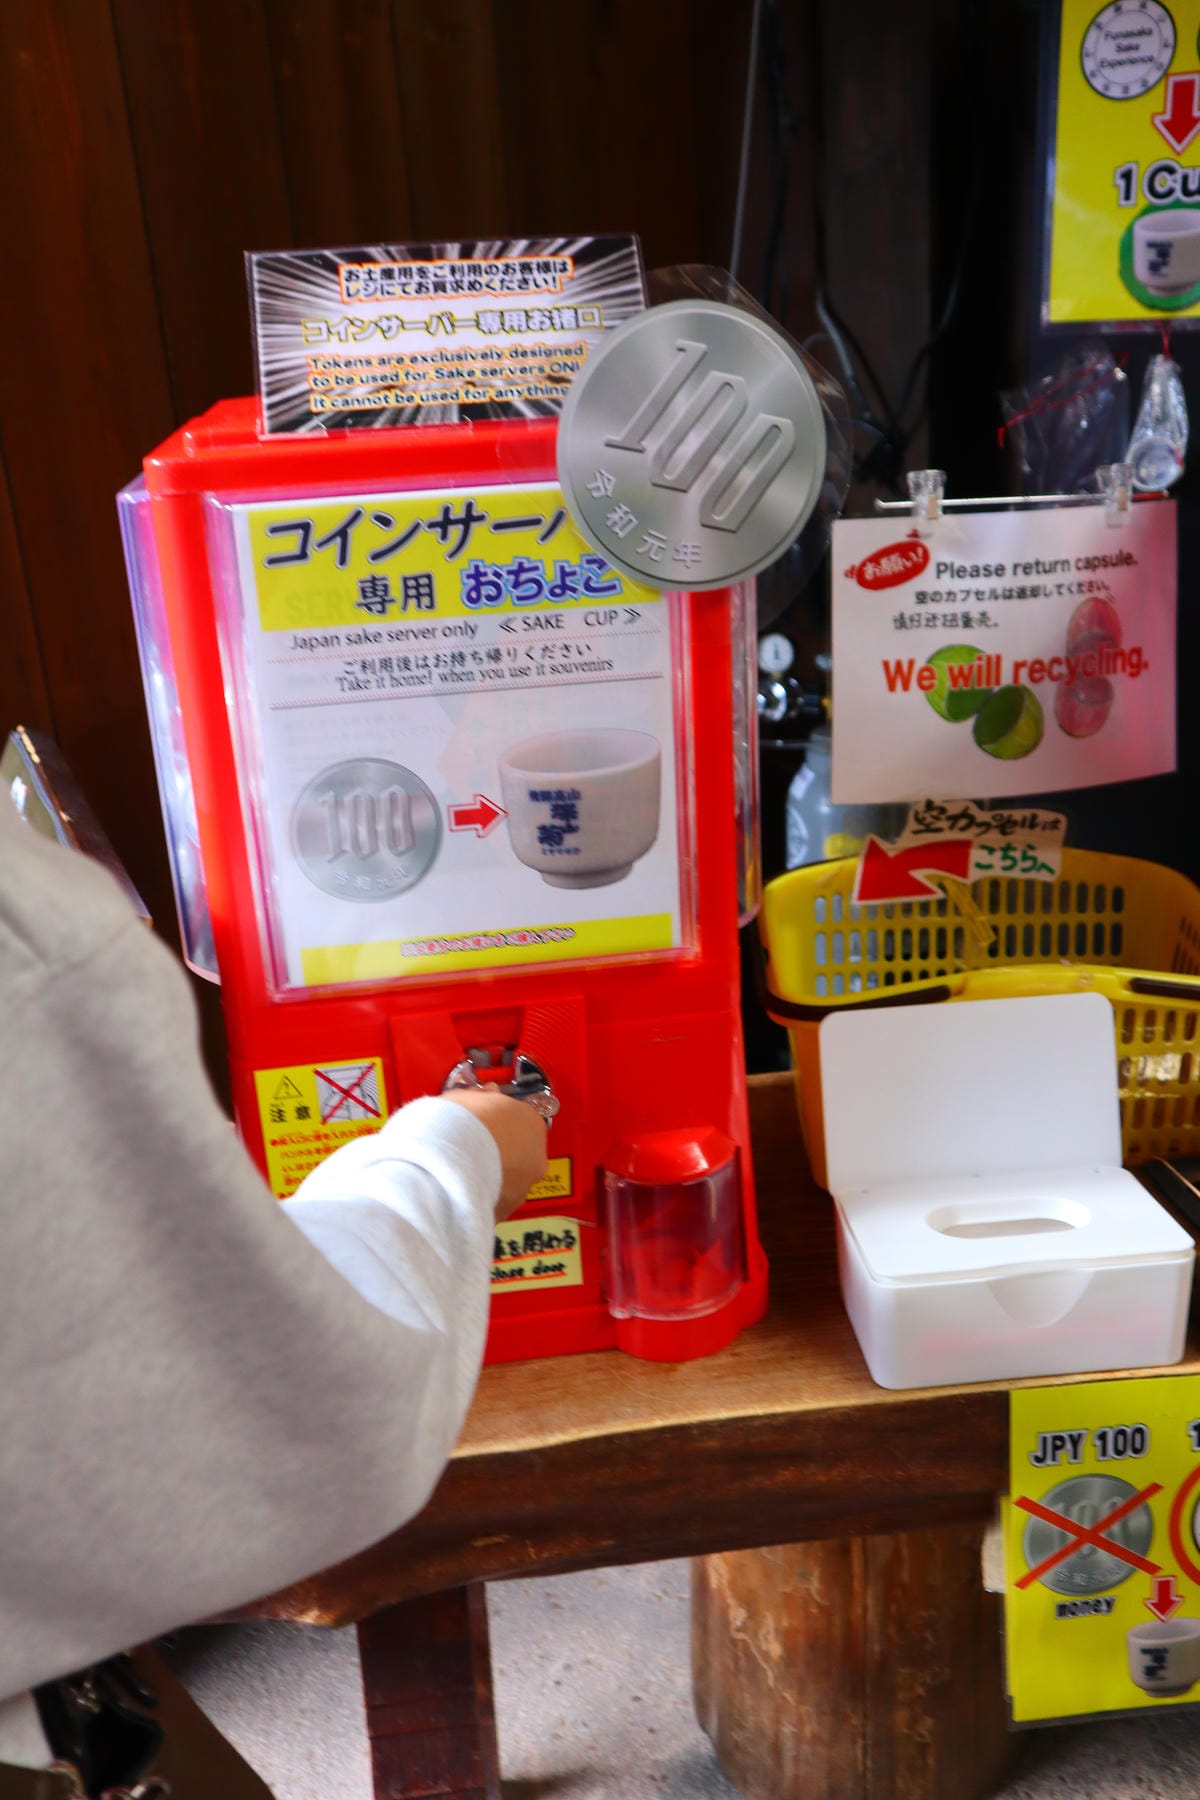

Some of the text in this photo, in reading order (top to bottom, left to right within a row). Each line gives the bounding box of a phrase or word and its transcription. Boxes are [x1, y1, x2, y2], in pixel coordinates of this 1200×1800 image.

[1116, 162, 1136, 205] 1
[303, 307, 602, 342] コインサーバー専用お猪口
[311, 344, 584, 370] Tokens are exclusively designed
[312, 375, 330, 387] to
[334, 372, 355, 386] be
[359, 370, 400, 384] used
[403, 368, 431, 382] for
[435, 365, 476, 380] Sake
[480, 361, 546, 377] servers
[331, 393, 390, 408] cannot
[394, 391, 416, 405] be
[419, 389, 460, 403] used
[463, 387, 490, 401] for
[604, 338, 796, 534] 100
[585, 467, 703, 569] 令和元年
[935, 550, 1138, 580] Please return capsule.
[356, 553, 624, 616] 専用 おちょこ
[291, 634, 341, 652] Japan
[345, 627, 383, 645] sake
[386, 628, 438, 641] server
[441, 620, 478, 639] only
[336, 675, 371, 692] Take
[390, 670, 433, 687] home!
[438, 667, 476, 683] when
[480, 667, 506, 682] you
[508, 665, 532, 678] use
[550, 657, 615, 674] souvenirs
[882, 645, 1150, 694] We will recycling.
[319, 782, 417, 865] 100
[974, 843, 1056, 875] こちらへ
[1031, 1429, 1088, 1467] JPY
[1094, 1423, 1149, 1461] 100
